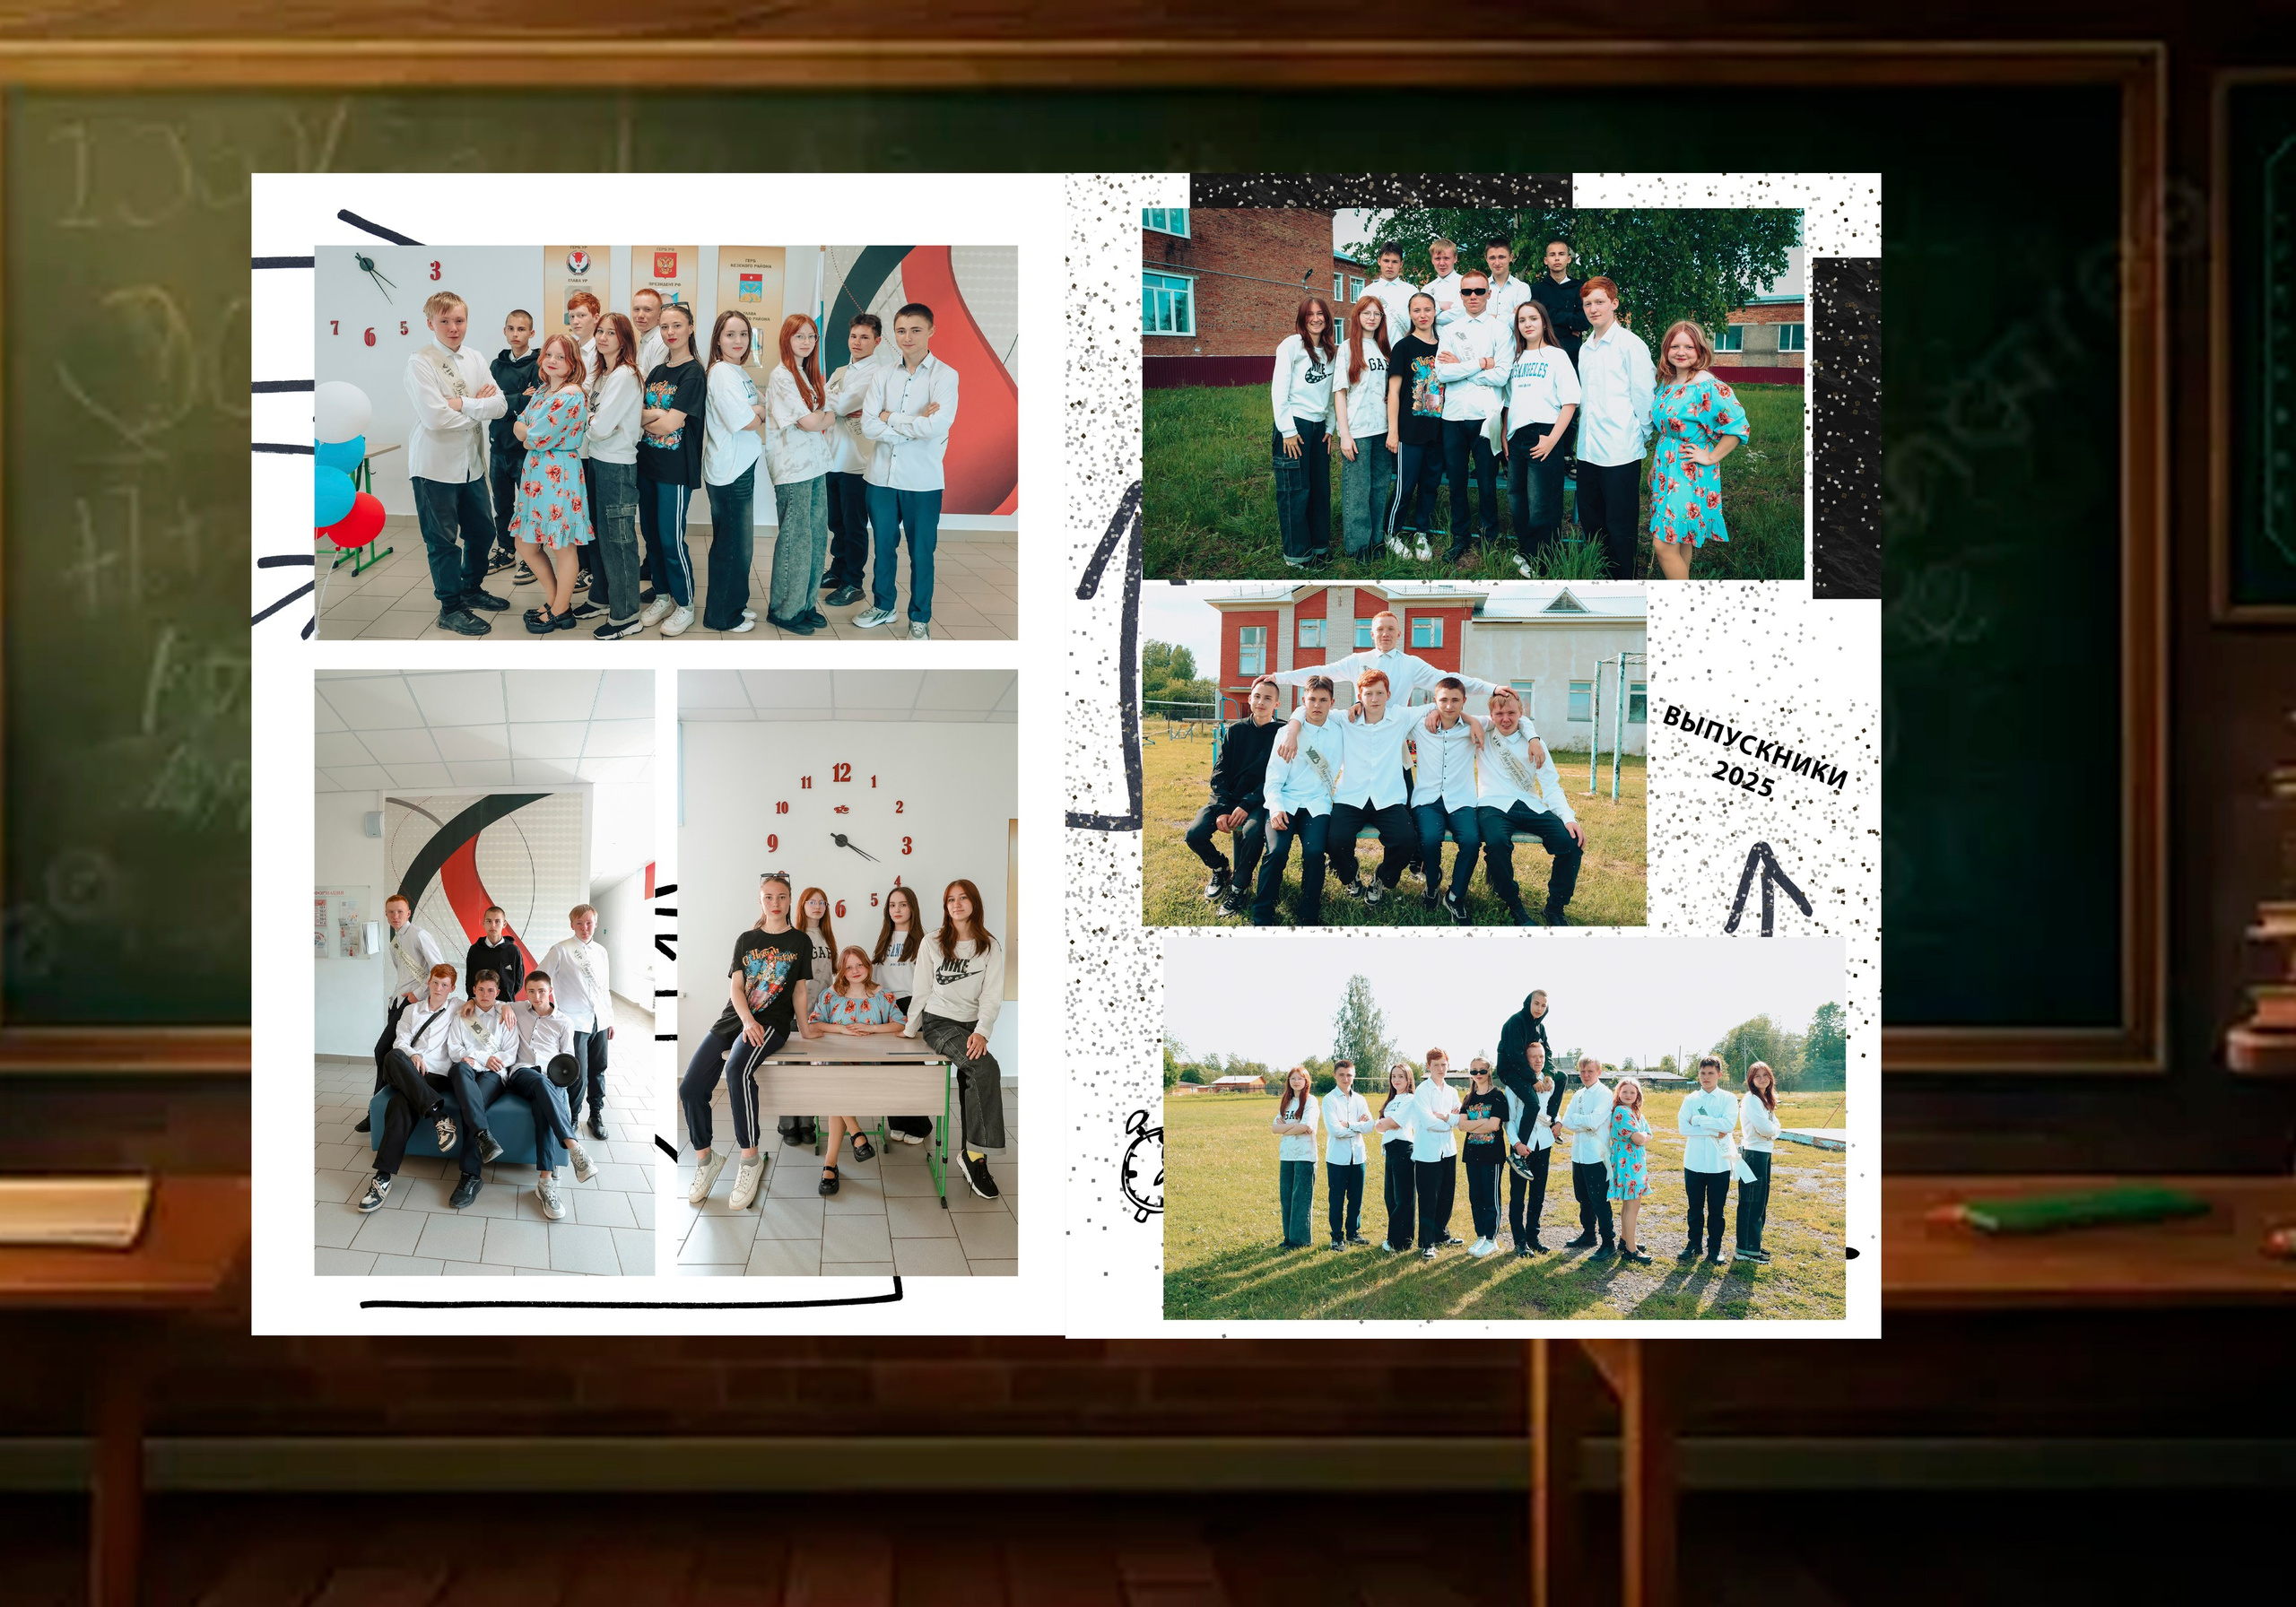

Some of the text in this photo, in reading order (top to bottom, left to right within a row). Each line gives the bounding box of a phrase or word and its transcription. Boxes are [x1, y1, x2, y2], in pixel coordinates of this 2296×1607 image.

[430, 260, 441, 281] 3
[330, 320, 339, 335] 7
[400, 320, 409, 335] 5
[364, 326, 376, 347] 6
[832, 762, 851, 783] 12
[800, 776, 813, 789] 11
[871, 775, 877, 788] 1
[776, 801, 789, 814] 10
[895, 800, 903, 814] 2
[767, 833, 778, 853] 9
[901, 836, 913, 856] 3
[870, 892, 879, 908] 5
[835, 899, 847, 918] 6
[941, 958, 970, 973] NIKE
